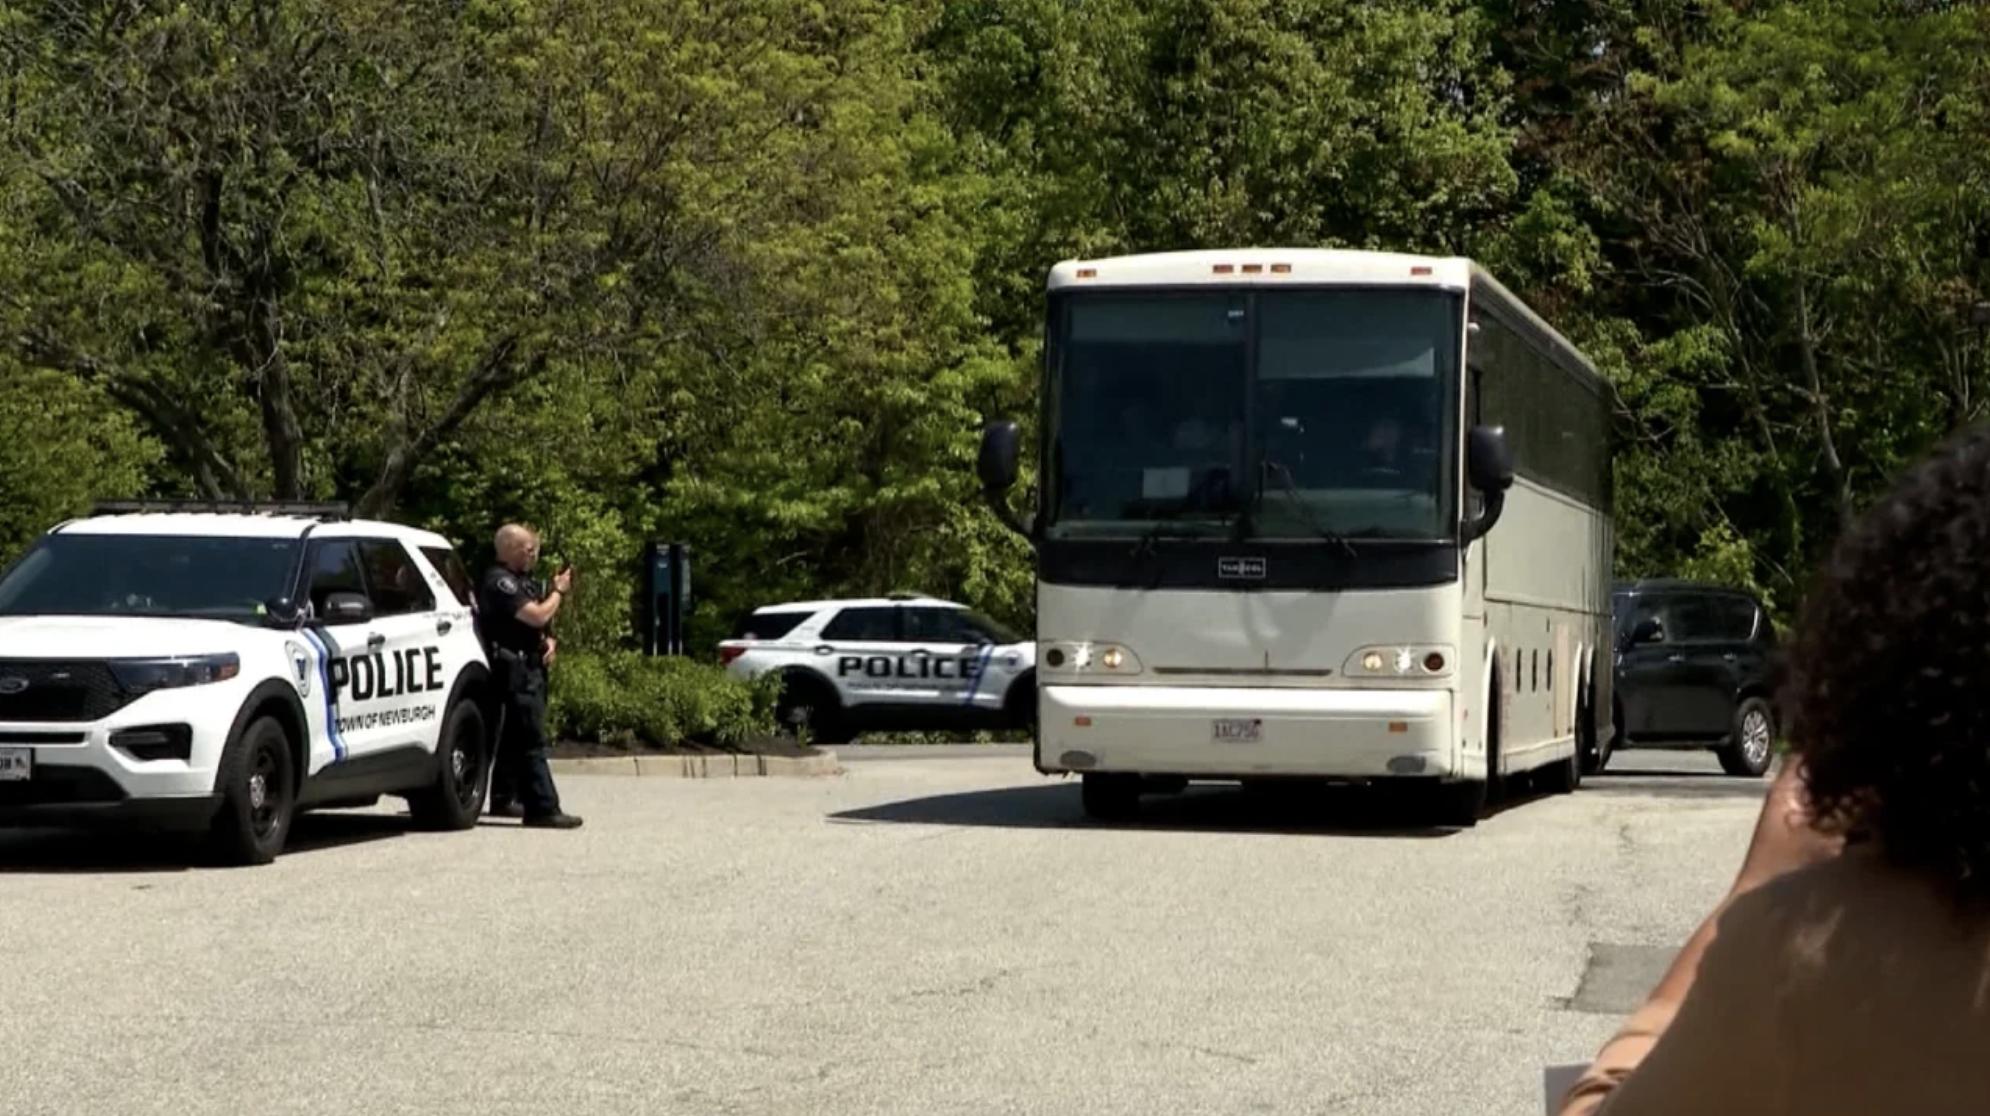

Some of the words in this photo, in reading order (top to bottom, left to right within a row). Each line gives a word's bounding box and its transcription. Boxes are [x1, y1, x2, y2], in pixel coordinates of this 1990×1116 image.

[328, 646, 444, 703] POLICE
[838, 656, 980, 679] POLICE
[364, 712, 378, 729] OF
[379, 705, 436, 727] NEWBURGH
